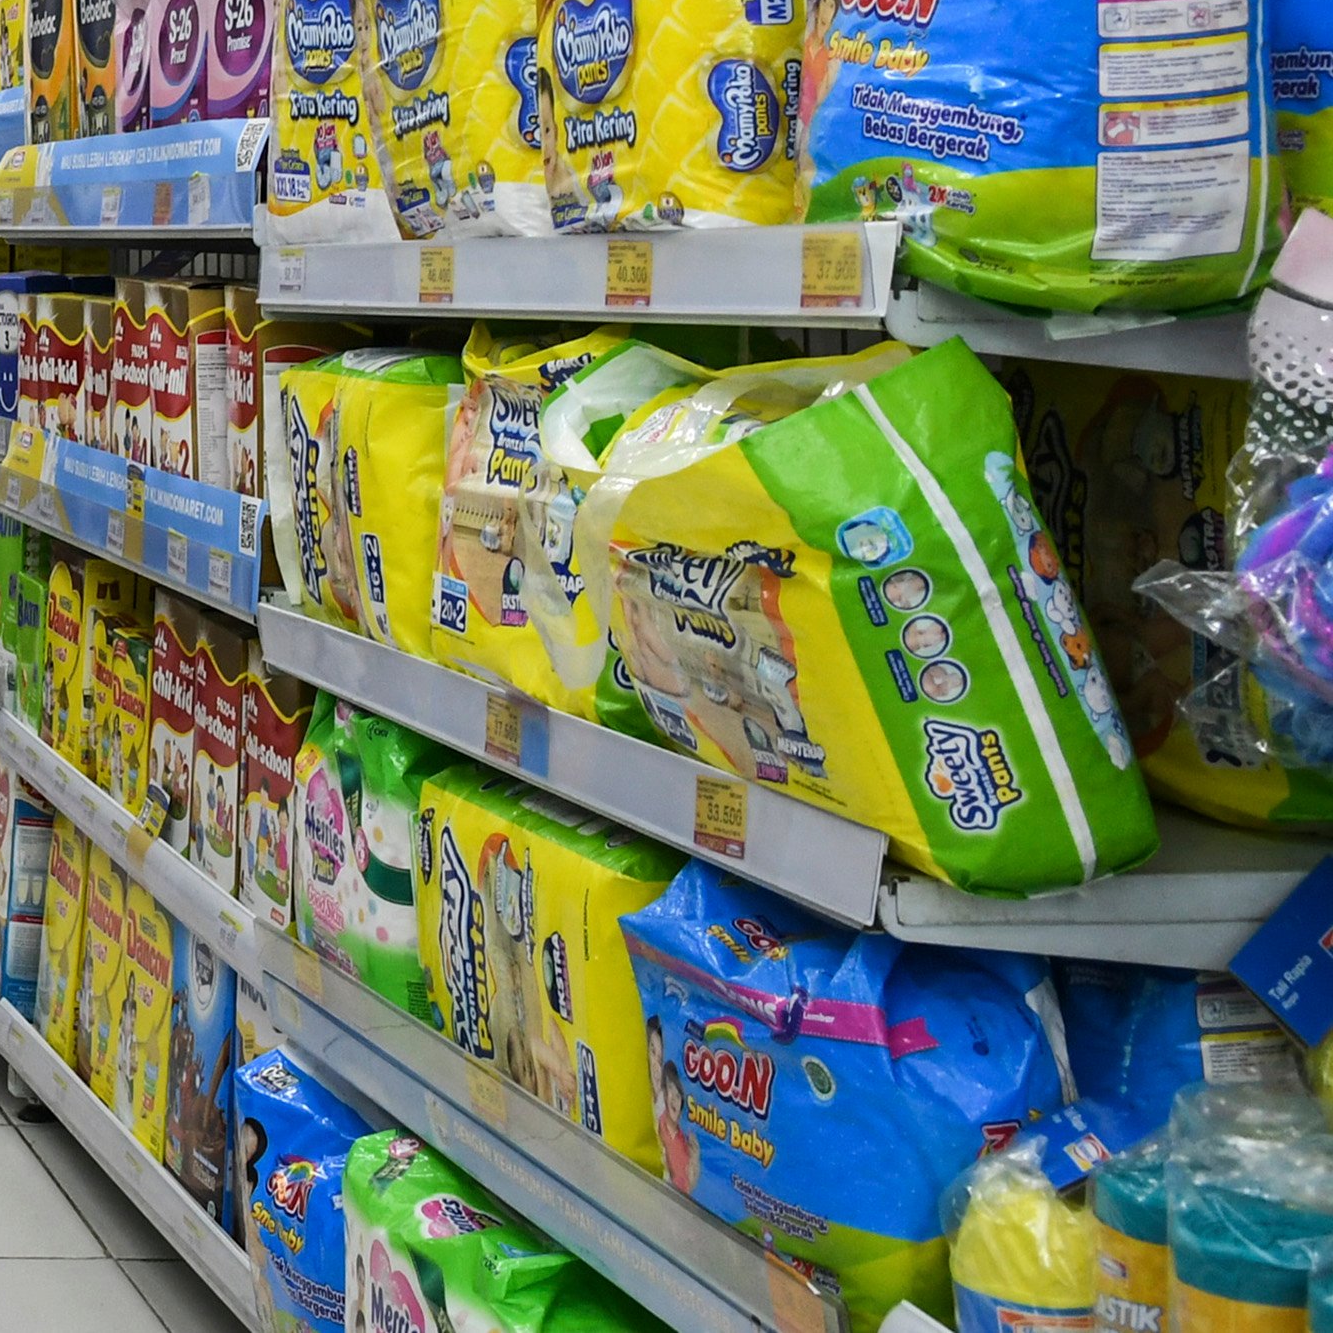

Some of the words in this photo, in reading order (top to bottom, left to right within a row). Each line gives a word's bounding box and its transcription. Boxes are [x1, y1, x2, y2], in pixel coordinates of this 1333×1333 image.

[169, 7, 193, 44] S-26
[287, 2, 356, 51] MamyPoko
[557, 7, 632, 76] MamyPoko
[304, 50, 333, 72] pants
[576, 59, 609, 94] pants
[829, 30, 874, 65] Smile
[874, 38, 930, 78] Baby
[289, 89, 315, 120] X-tra
[316, 89, 358, 126] Kering
[415, 90, 451, 126] Kering
[784, 61, 801, 113] Kering
[565, 114, 596, 153] X-tra
[595, 106, 636, 146] Kering
[724, 64, 762, 170] MamyPoko
[756, 93, 776, 138] pants
[853, 84, 887, 110] Tidak
[887, 89, 1024, 144] Menggembung,
[864, 114, 906, 144] Bebas
[907, 123, 990, 161] Bergerak
[928, 184, 946, 204] 2X
[946, 199, 975, 215] Kering
[616, 266, 648, 284] 40.300
[3, 330, 11, 351] 3
[929, 727, 989, 824] Sweety
[980, 732, 1020, 804] Pants
[305, 801, 346, 862] Merries
[707, 802, 742, 825] 33.500
[471, 889, 495, 1059] Pants
[682, 1037, 775, 1118] GOO.N
[687, 1093, 728, 1140] Smile
[730, 1120, 775, 1169] Baby
[768, 1212, 815, 1243] Bergerak
